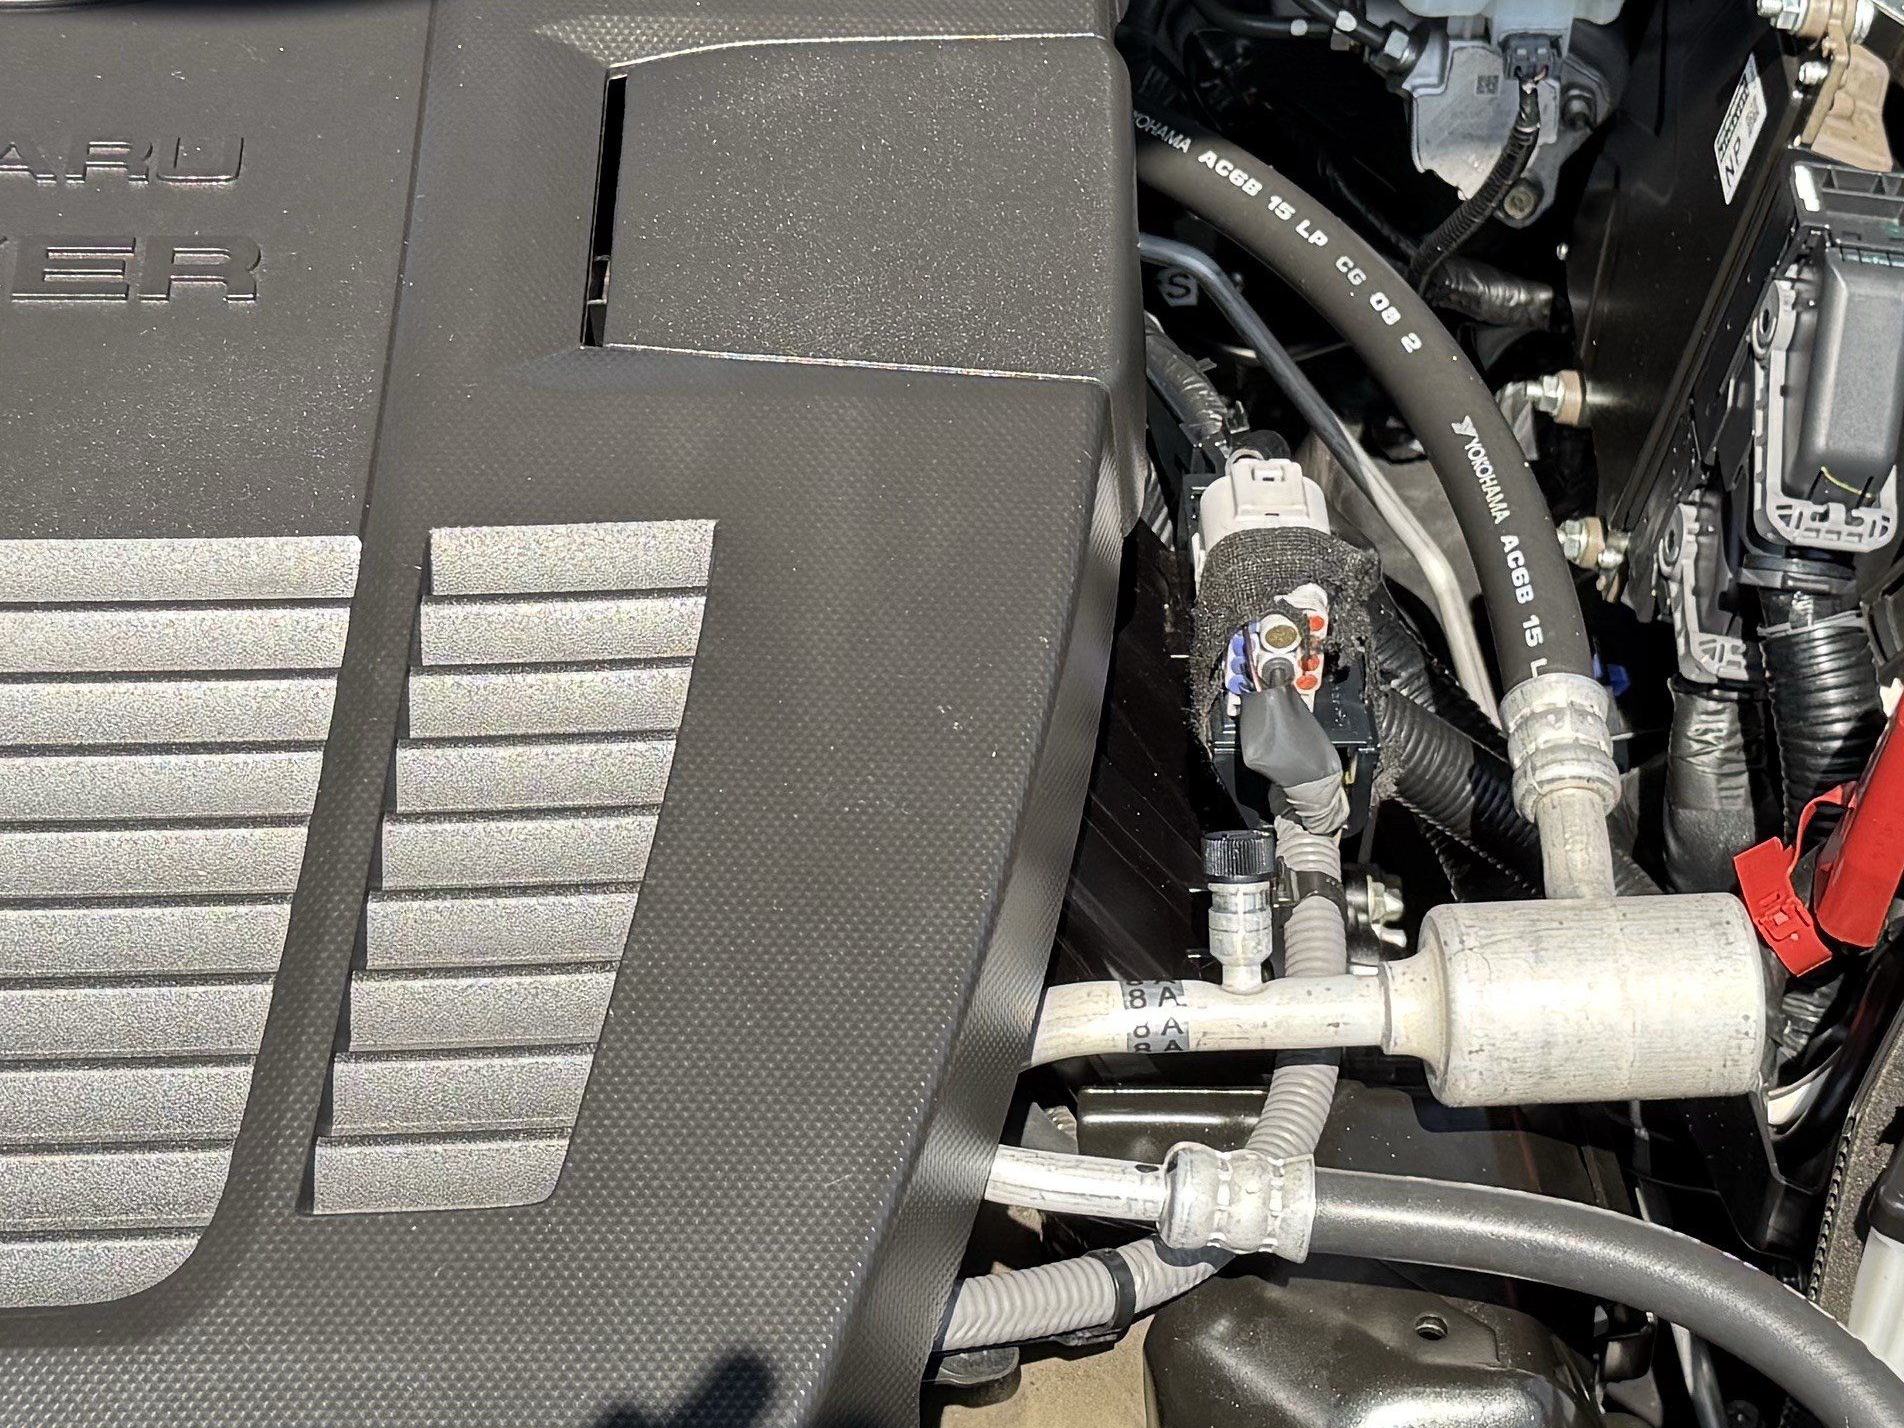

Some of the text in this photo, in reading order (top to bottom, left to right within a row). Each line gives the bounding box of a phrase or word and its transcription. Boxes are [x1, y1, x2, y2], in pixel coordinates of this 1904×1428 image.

[1133, 111, 1192, 153] OHAMA
[1198, 150, 1263, 197] AC6B
[1267, 195, 1296, 221] 15
[1295, 219, 1329, 247] LP
[1335, 255, 1367, 286] CG
[1464, 437, 1511, 525] YOKOHAMA
[1500, 534, 1534, 605] AC6B
[1522, 614, 1544, 648] 15
